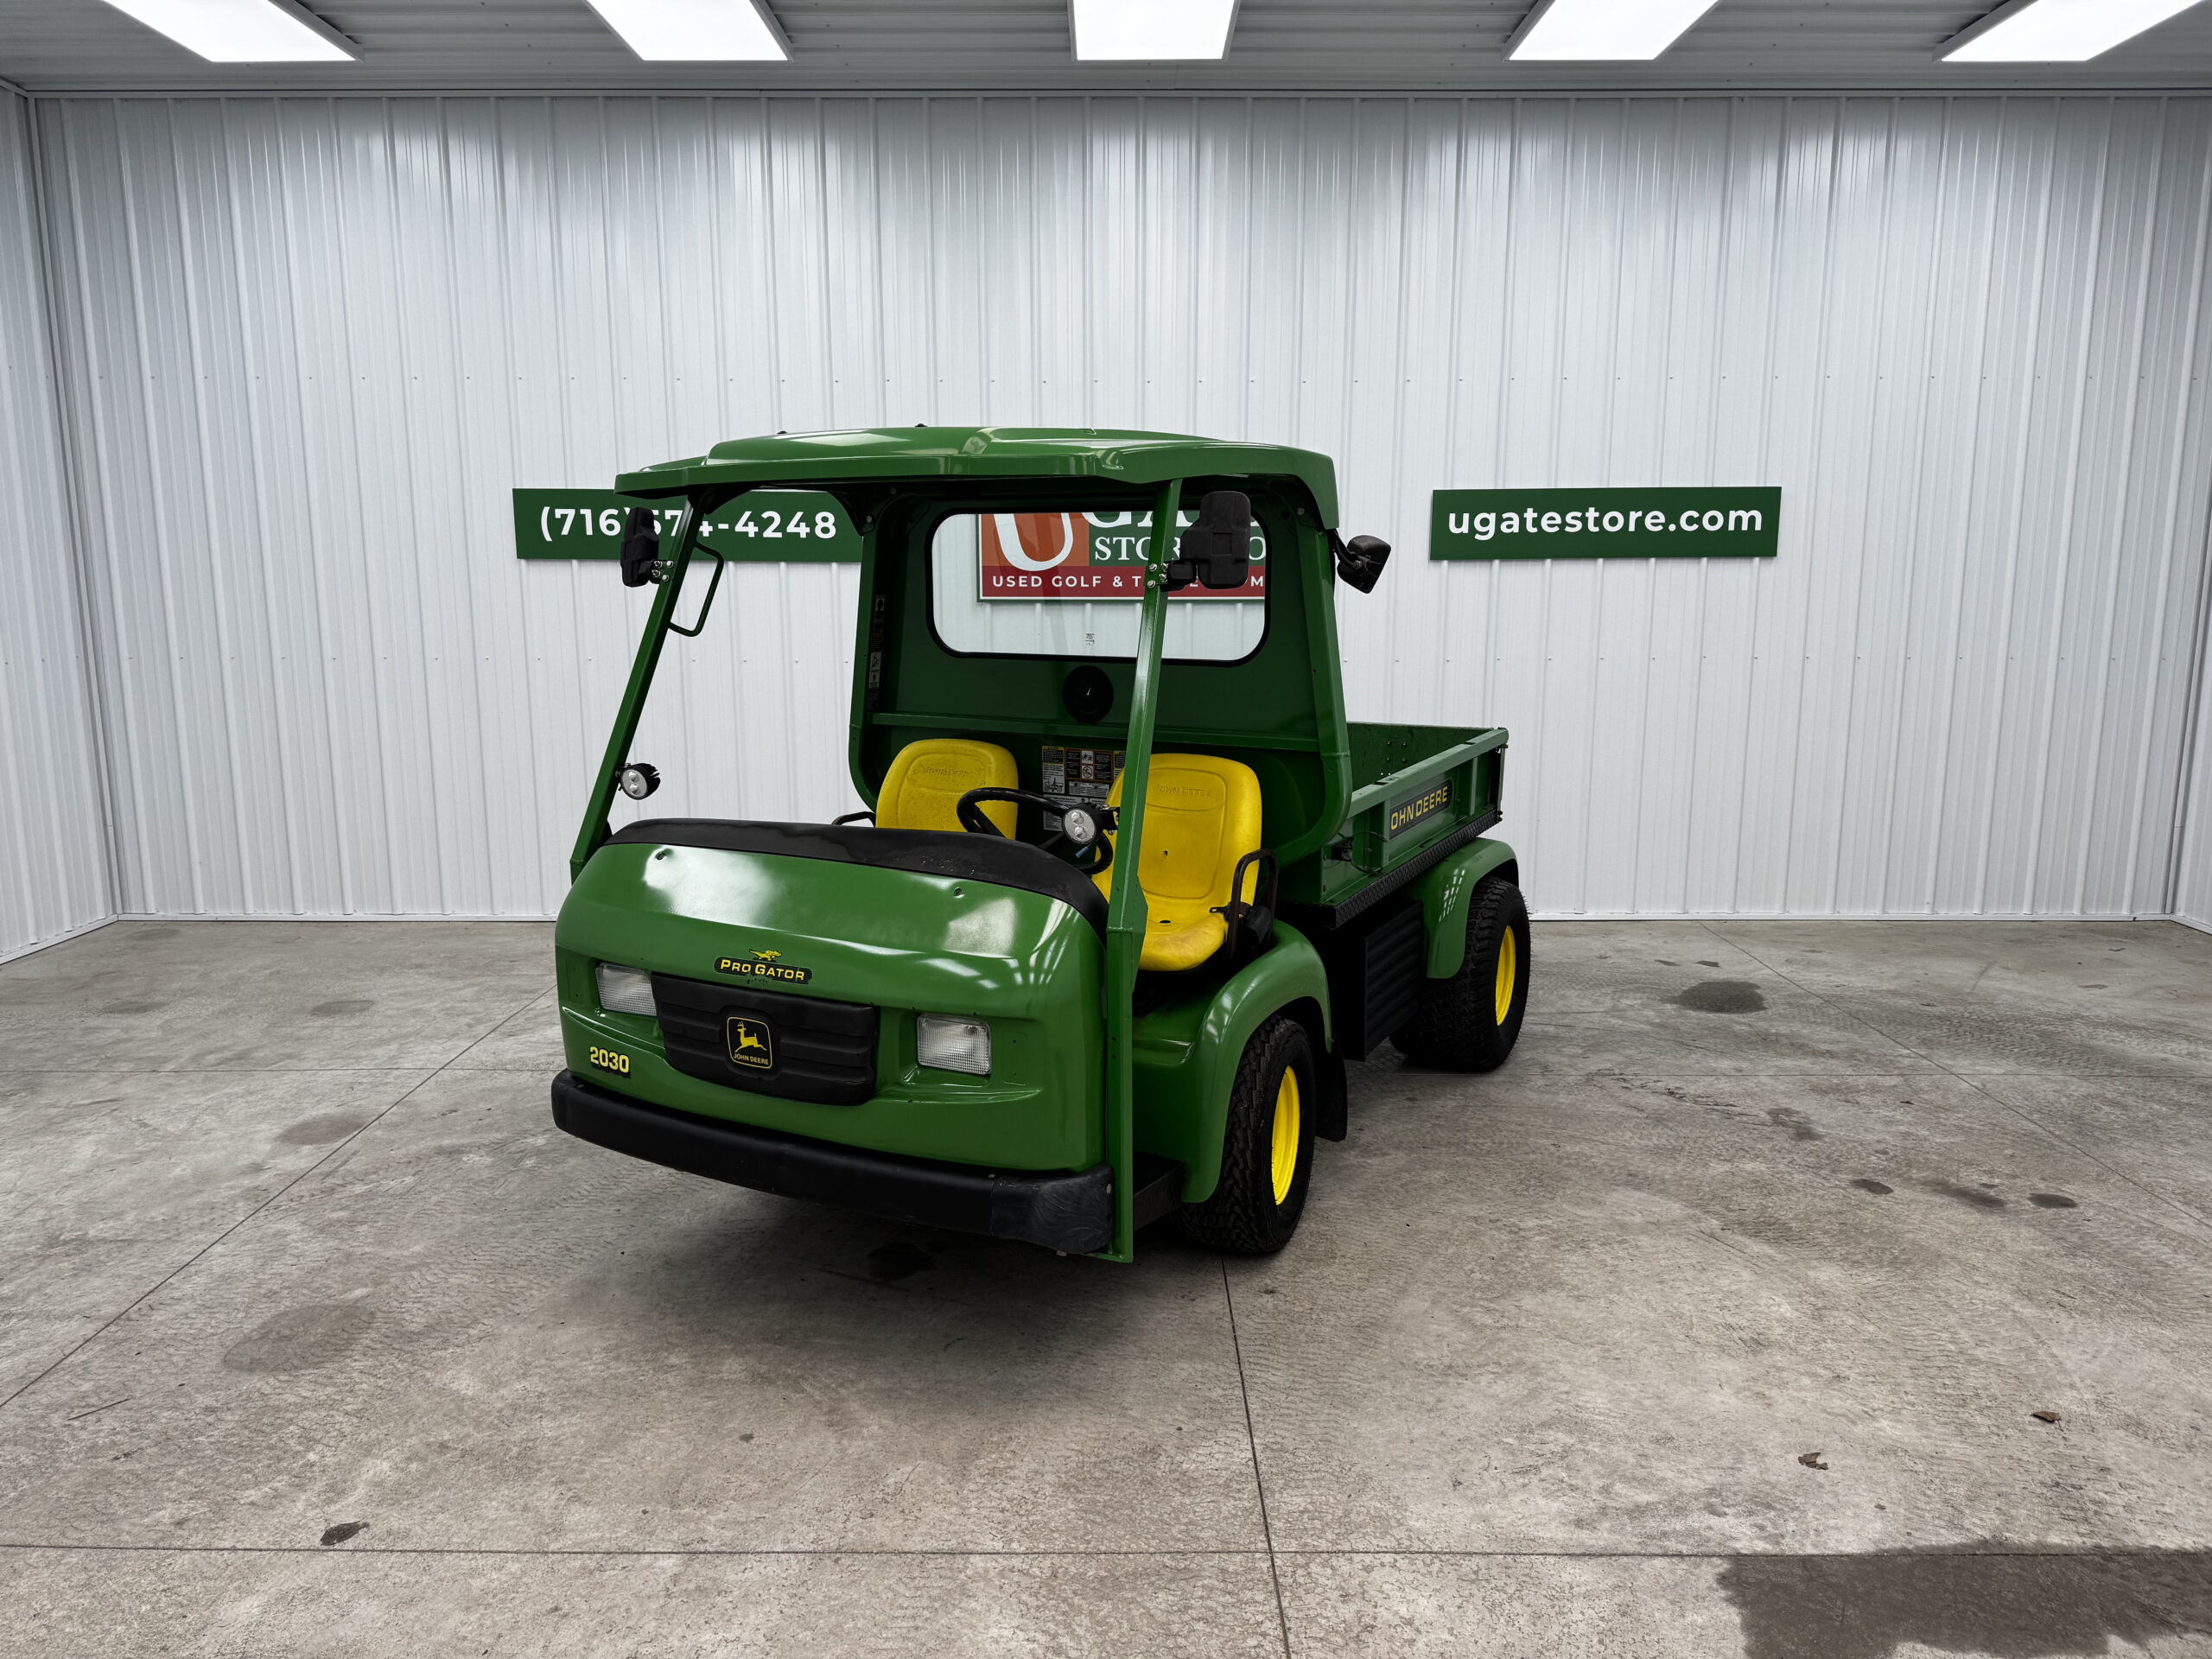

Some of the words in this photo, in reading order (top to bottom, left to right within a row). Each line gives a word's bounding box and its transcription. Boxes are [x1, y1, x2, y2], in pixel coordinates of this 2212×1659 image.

[541, 506, 837, 541] (7167-4248
[1449, 506, 1762, 540] ugatestore.com
[993, 575, 1042, 588] USED
[1052, 575, 1102, 588] GOLF
[1112, 575, 1123, 588] &
[1391, 803, 1414, 830] OHN
[1415, 785, 1448, 817] DEERE
[589, 1046, 630, 1073] 2030
[734, 1052, 749, 1062] JOHN
[749, 1056, 769, 1065] DEERE
